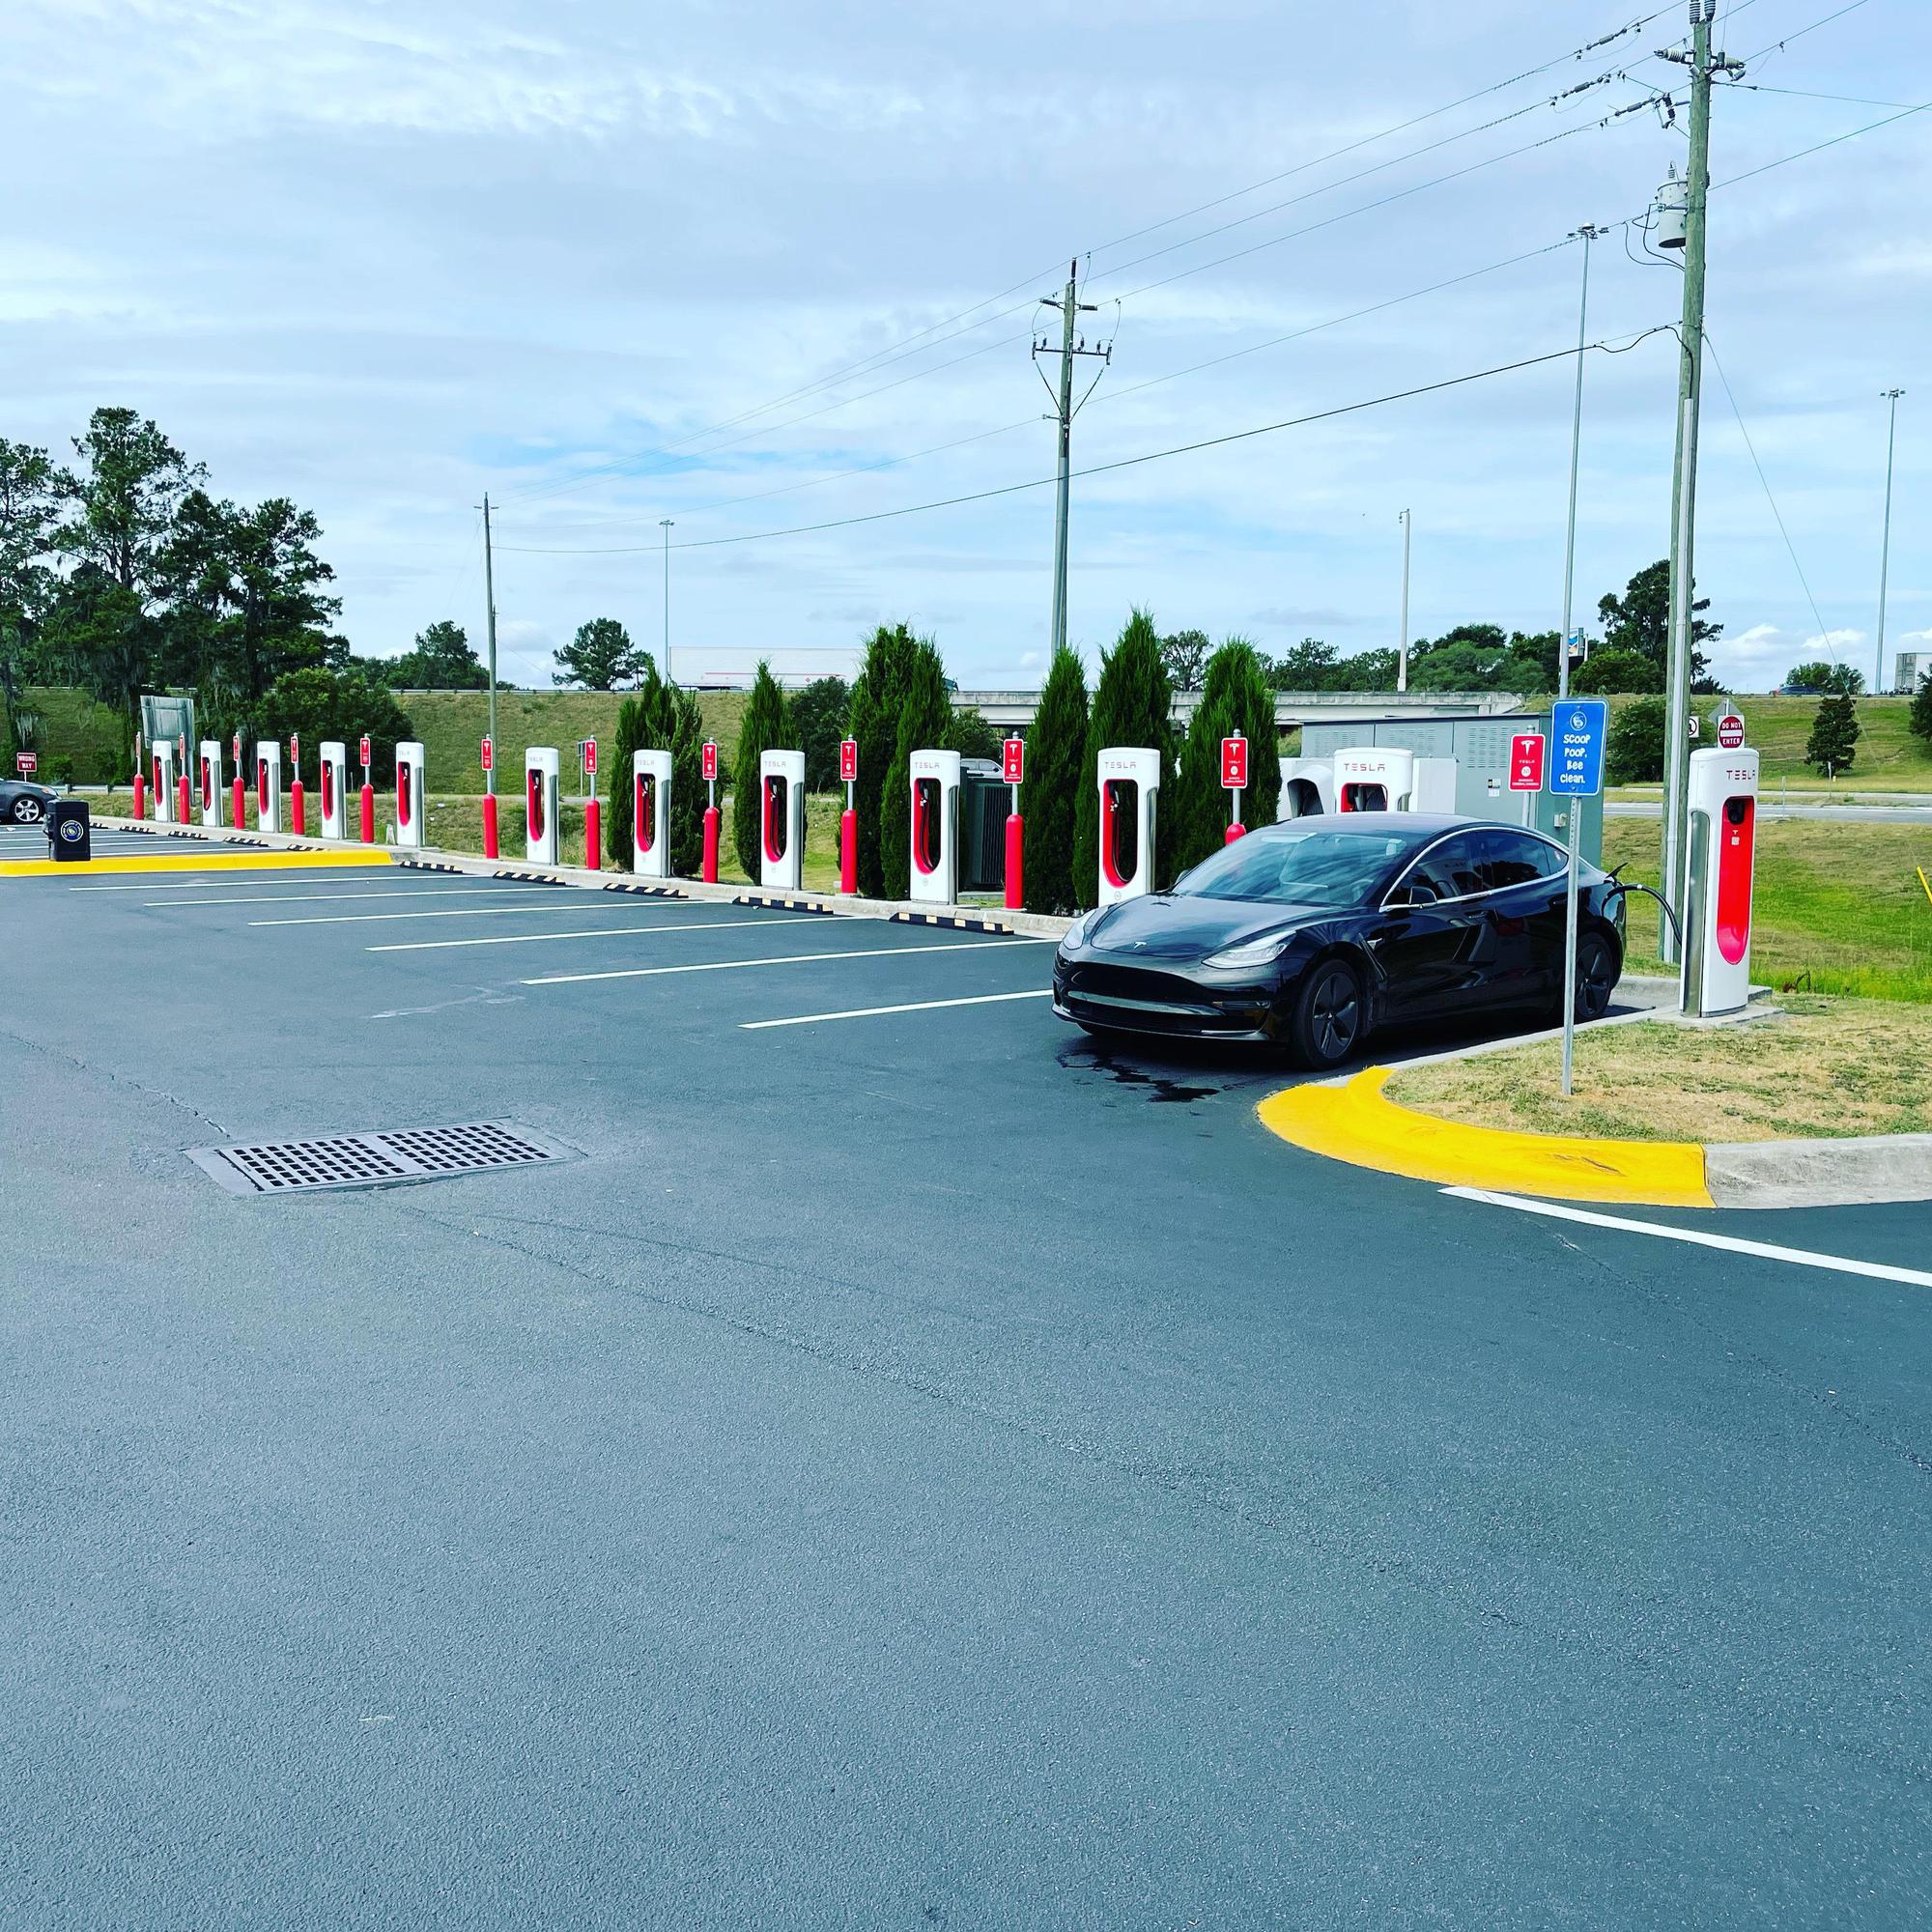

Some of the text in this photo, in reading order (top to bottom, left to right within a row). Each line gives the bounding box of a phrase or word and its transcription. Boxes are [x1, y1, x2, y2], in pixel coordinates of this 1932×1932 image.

[1563, 734, 1591, 744] SCOOP
[1344, 763, 1386, 772] TESLA
[1567, 760, 1583, 770] Bee
[1560, 773, 1585, 783] Clean.
[1725, 769, 1755, 781] TESLA
